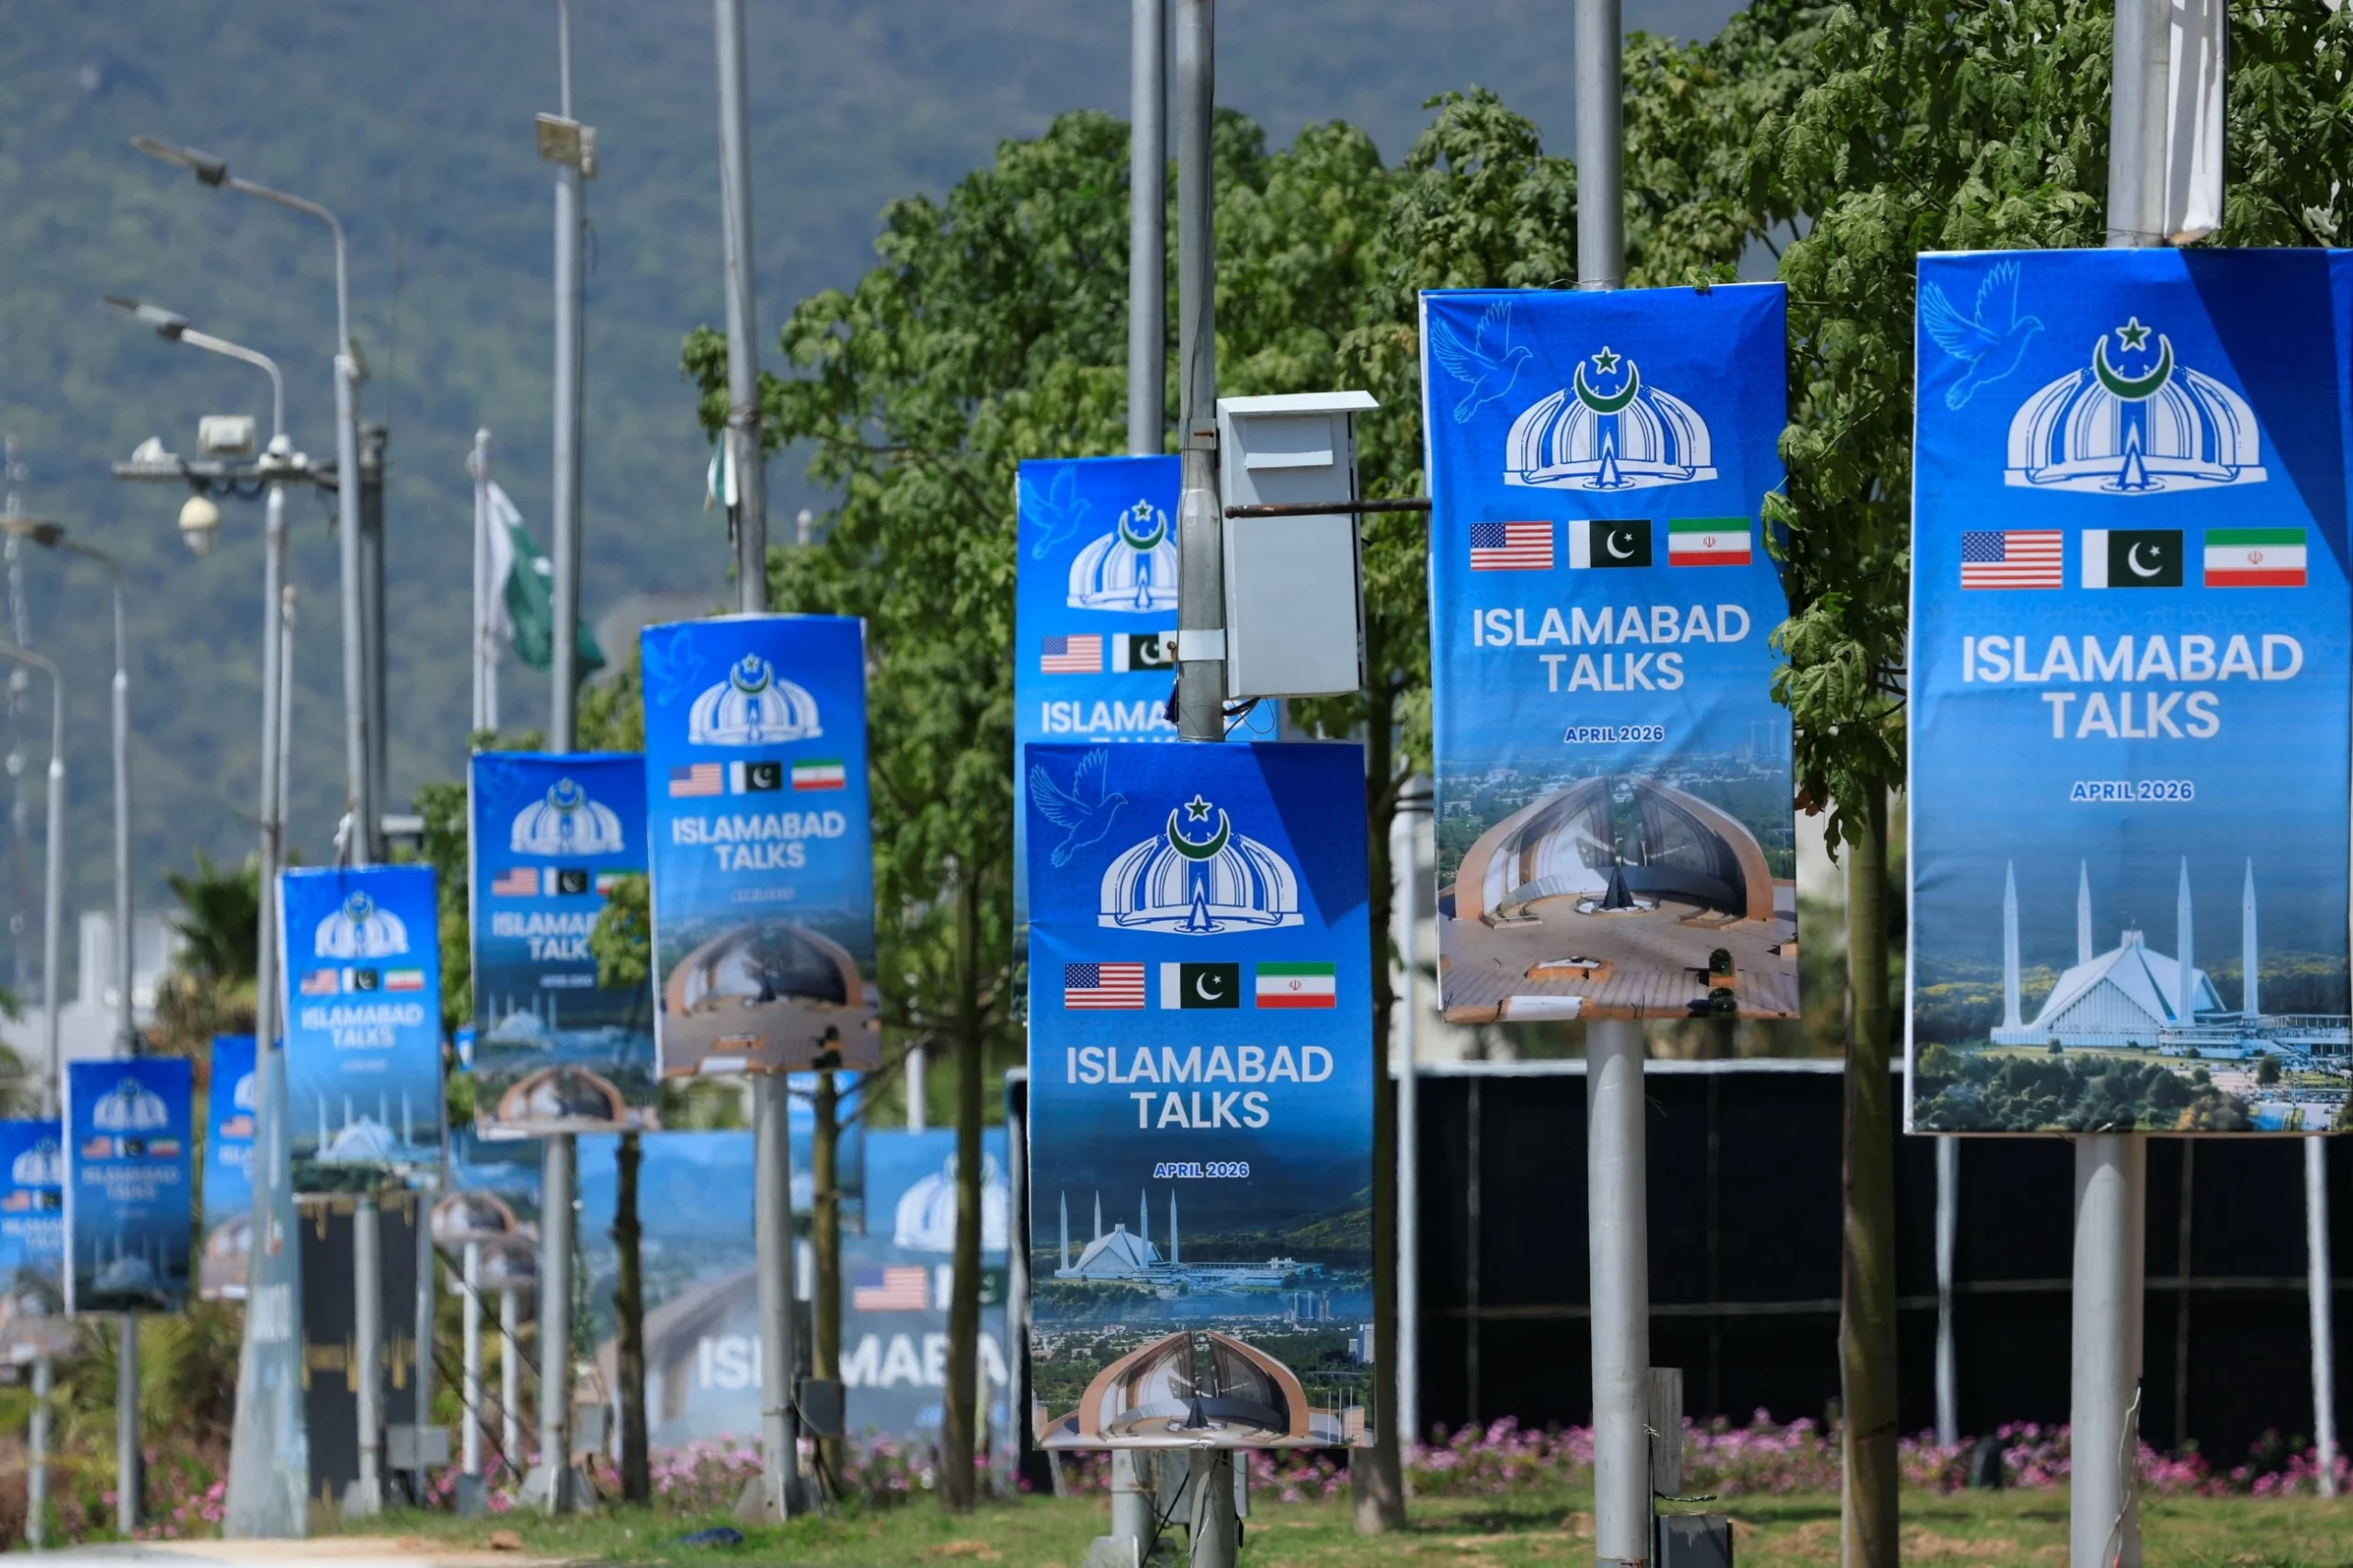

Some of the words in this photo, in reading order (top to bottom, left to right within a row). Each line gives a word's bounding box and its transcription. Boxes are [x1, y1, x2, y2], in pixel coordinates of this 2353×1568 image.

[1473, 604, 1751, 647] ISLAMABAD
[1539, 652, 1684, 692] TALKS
[1962, 633, 2303, 683] ISLAMABAD
[2041, 690, 2221, 739] TALKS
[1563, 726, 1616, 744] APRIL
[1619, 724, 1665, 742] 2026
[2070, 780, 2135, 801] APRIL
[2138, 779, 2195, 801] 2026
[672, 811, 846, 845] ISLAMABAD
[714, 841, 806, 871] TALKS
[528, 937, 591, 961] TALK
[301, 1003, 425, 1030] ISLAMABAD
[332, 1027, 396, 1050] TALKS
[1066, 1045, 1334, 1085] ISLAMABAD
[1130, 1091, 1270, 1130] TALKS
[1153, 1162, 1203, 1178] APRIL
[1205, 1161, 1250, 1177] 2026
